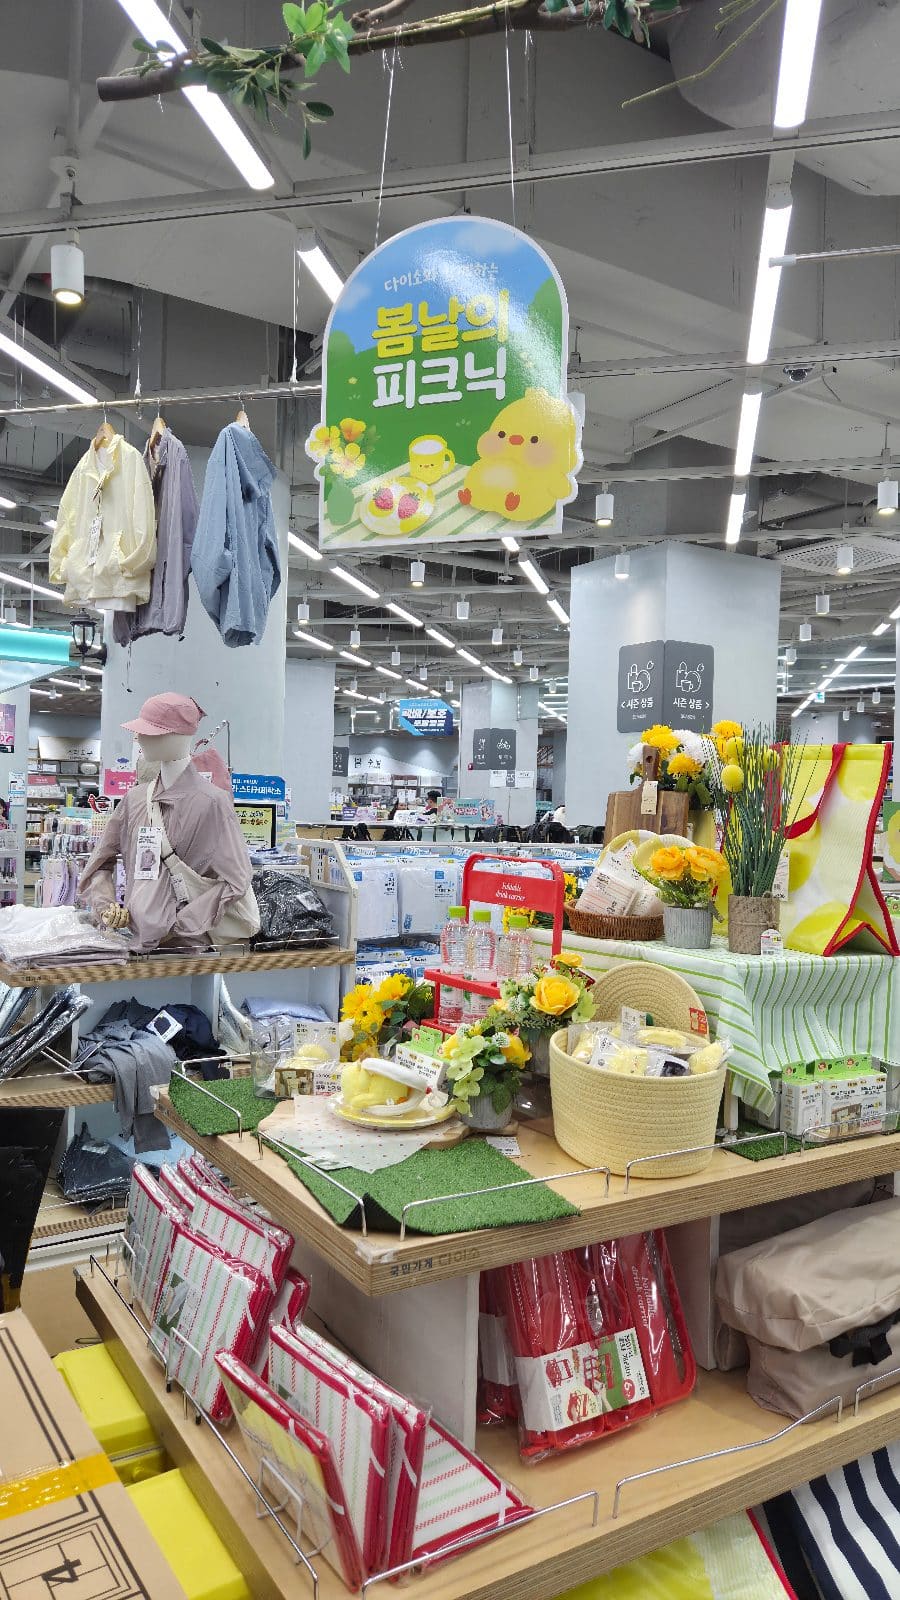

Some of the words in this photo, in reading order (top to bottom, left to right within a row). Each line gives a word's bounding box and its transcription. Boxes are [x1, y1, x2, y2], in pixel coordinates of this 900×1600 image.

[372, 289, 510, 359] 봄날의
[373, 347, 508, 409] 피크닉
[626, 698, 639, 710] 시즌
[640, 697, 654, 709] 상품
[673, 697, 688, 709] 시즌
[688, 698, 703, 710] 상품
[390, 1257, 433, 1277] 국민가게
[438, 1247, 480, 1266] 다이소
[631, 1265, 642, 1292] drink
[636, 1292, 649, 1329] carrier
